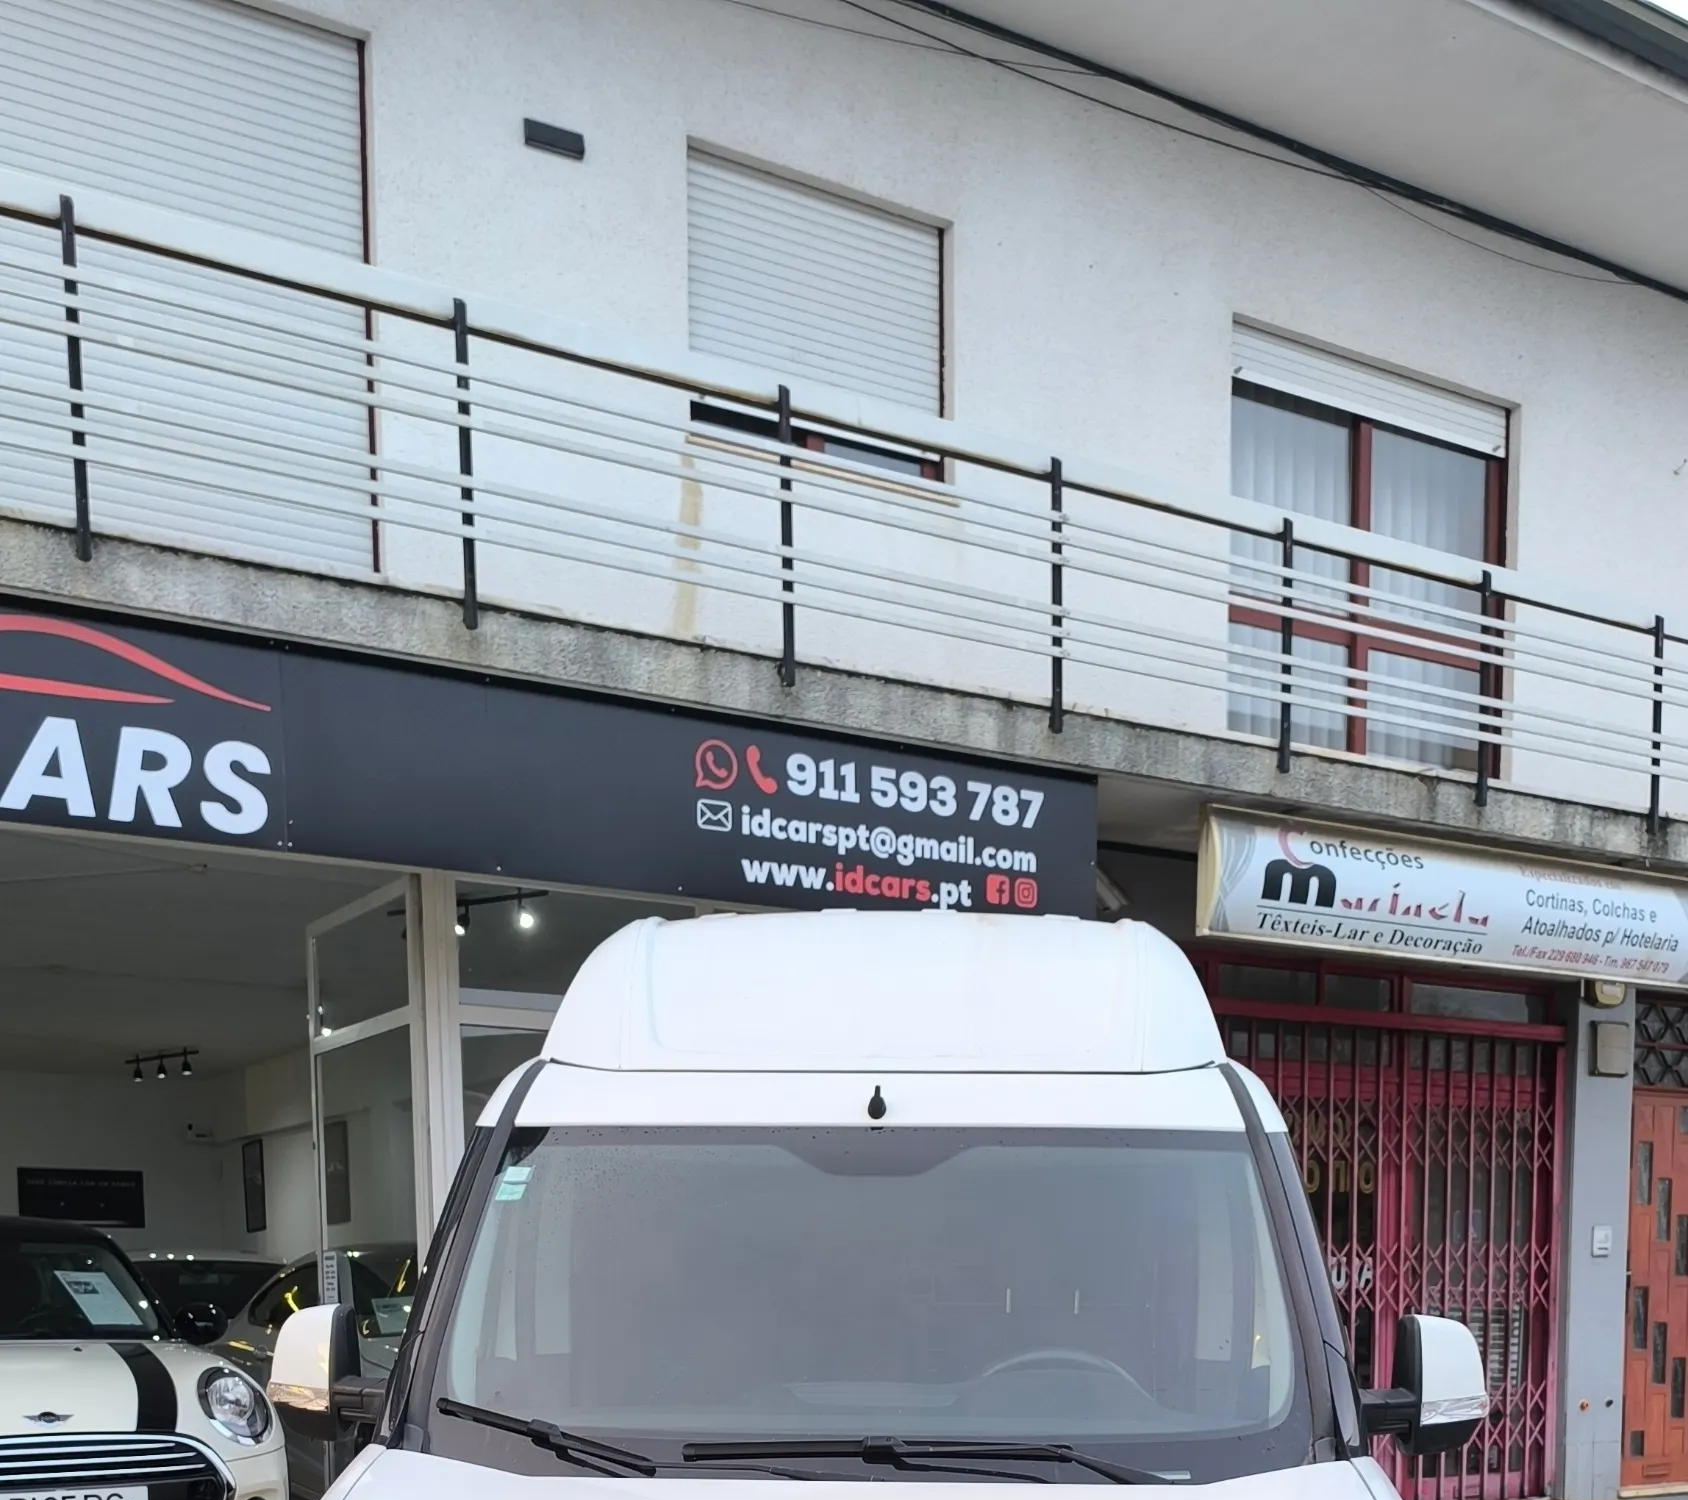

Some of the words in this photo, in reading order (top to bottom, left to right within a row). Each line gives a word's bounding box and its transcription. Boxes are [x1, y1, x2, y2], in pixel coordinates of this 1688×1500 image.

[786, 753, 860, 805] 911
[870, 765, 957, 818] 593
[966, 781, 1045, 829] 787
[741, 806, 1037, 873] idcarspt@gmail.com
[741, 858, 973, 909] www.idcars.pt
[1526, 889, 1588, 916] Cortinas,
[1592, 899, 1645, 922] Colchas
[1649, 909, 1658, 923] e
[1257, 911, 1370, 942] Têxteis-Lar
[1374, 930, 1384, 944] e
[1387, 928, 1483, 956] Decoração
[1521, 916, 1602, 943] Atoalhados
[1620, 928, 1679, 952] Hotelaria
